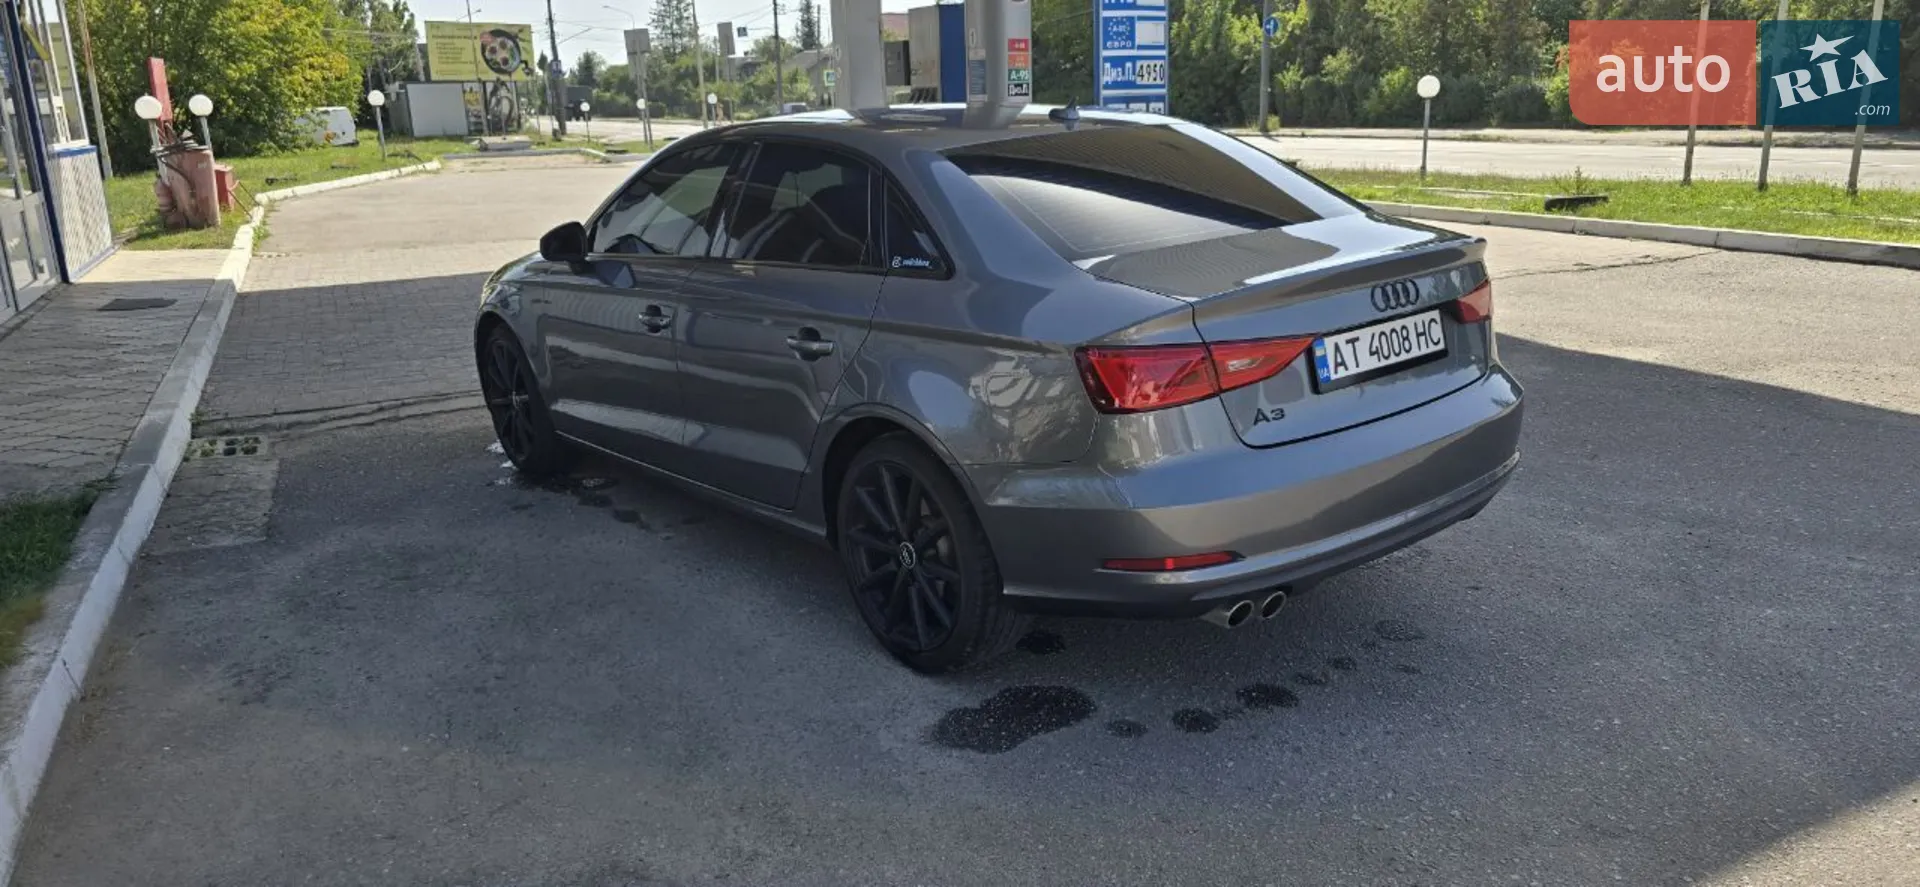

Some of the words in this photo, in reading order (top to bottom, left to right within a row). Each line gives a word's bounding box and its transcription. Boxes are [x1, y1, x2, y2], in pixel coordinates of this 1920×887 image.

[1137, 63, 1164, 82] 4950
[1333, 336, 1360, 374] AT
[1369, 324, 1412, 363] 4008
[1414, 319, 1441, 351] HC
[1319, 366, 1330, 379] UA
[1253, 407, 1286, 426] A3
